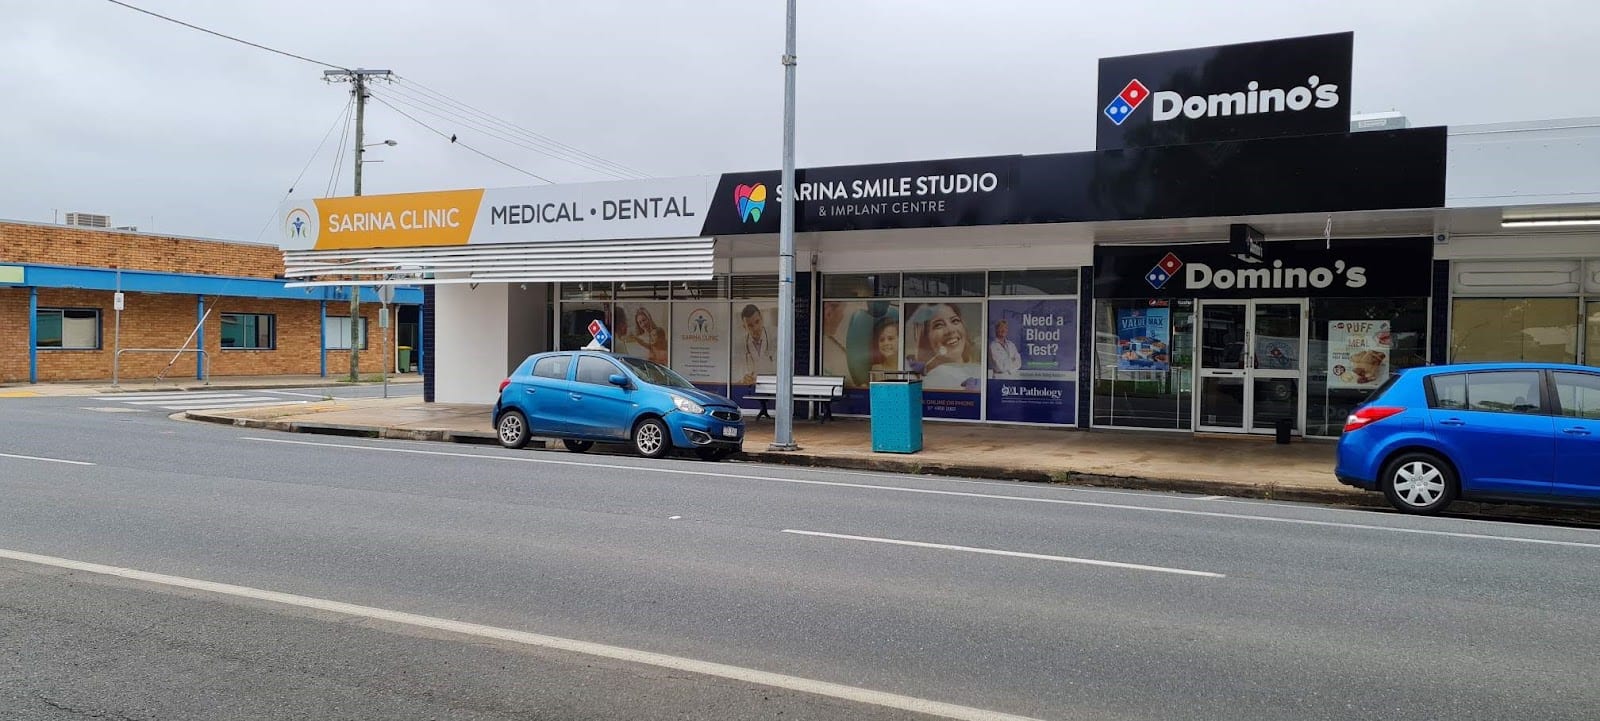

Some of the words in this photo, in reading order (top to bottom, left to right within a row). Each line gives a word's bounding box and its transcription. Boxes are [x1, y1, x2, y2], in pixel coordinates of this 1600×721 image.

[1152, 75, 1339, 121] Domino's
[775, 180, 848, 203] SRINA
[852, 177, 912, 199] SMILE
[916, 172, 998, 195] STUDIO
[491, 202, 584, 226] MEDICAL
[602, 196, 696, 221] DENTAL
[818, 207, 827, 217] &
[831, 203, 887, 216] IMPLANT
[892, 200, 945, 213] CENTRE
[328, 211, 396, 234] SARINA
[400, 208, 460, 231] CLINIC
[1185, 259, 1368, 290] Domino's
[1023, 313, 1053, 327] Need
[1056, 316, 1064, 326] a
[1122, 318, 1145, 329] VALUE
[1148, 318, 1163, 326] MAX
[1346, 322, 1373, 333] PUFF
[1026, 328, 1061, 341] Blood
[1027, 343, 1059, 356] Test?
[1019, 386, 1063, 398] Pathology
